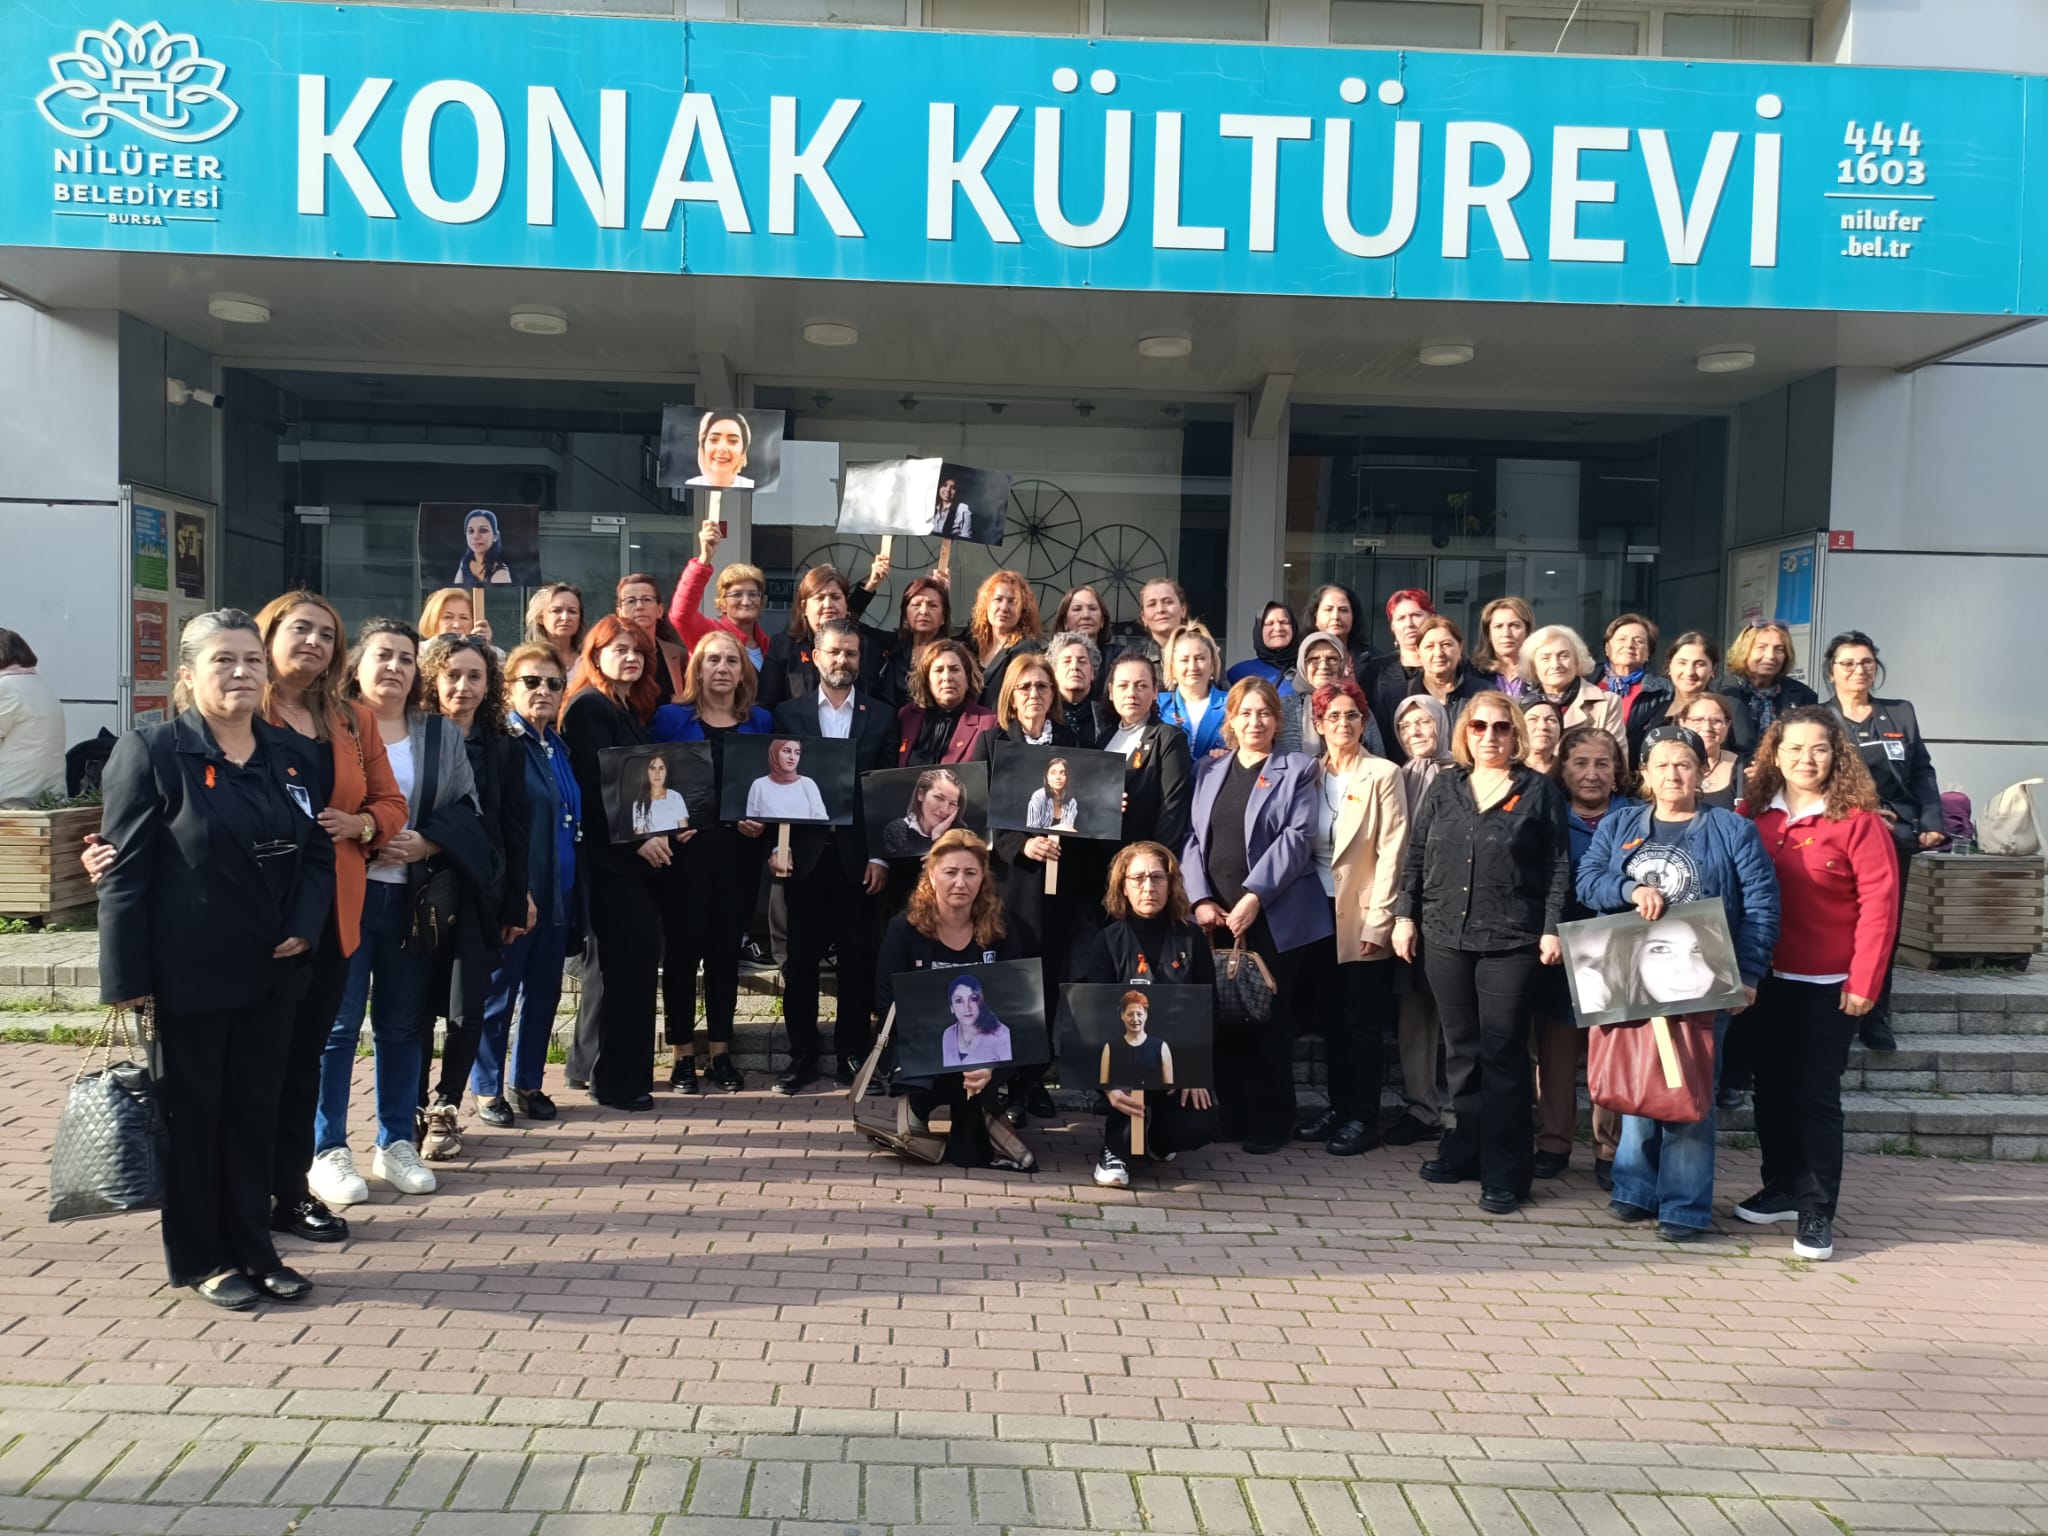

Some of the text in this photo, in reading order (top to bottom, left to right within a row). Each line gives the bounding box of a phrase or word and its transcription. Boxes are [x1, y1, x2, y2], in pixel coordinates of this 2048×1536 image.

[1843, 120, 1921, 156] 444
[54, 143, 222, 180] NİLÜFER
[298, 68, 1782, 267] KONAK KÜLTÜREVİ
[1837, 152, 1926, 185] 1603
[54, 182, 219, 208] BELEDİYESİ
[108, 213, 163, 226] BURSA
[1840, 209, 1923, 231] nilufer
[1841, 235, 1911, 258] .bel.tr
[1838, 535, 1845, 545] 2
